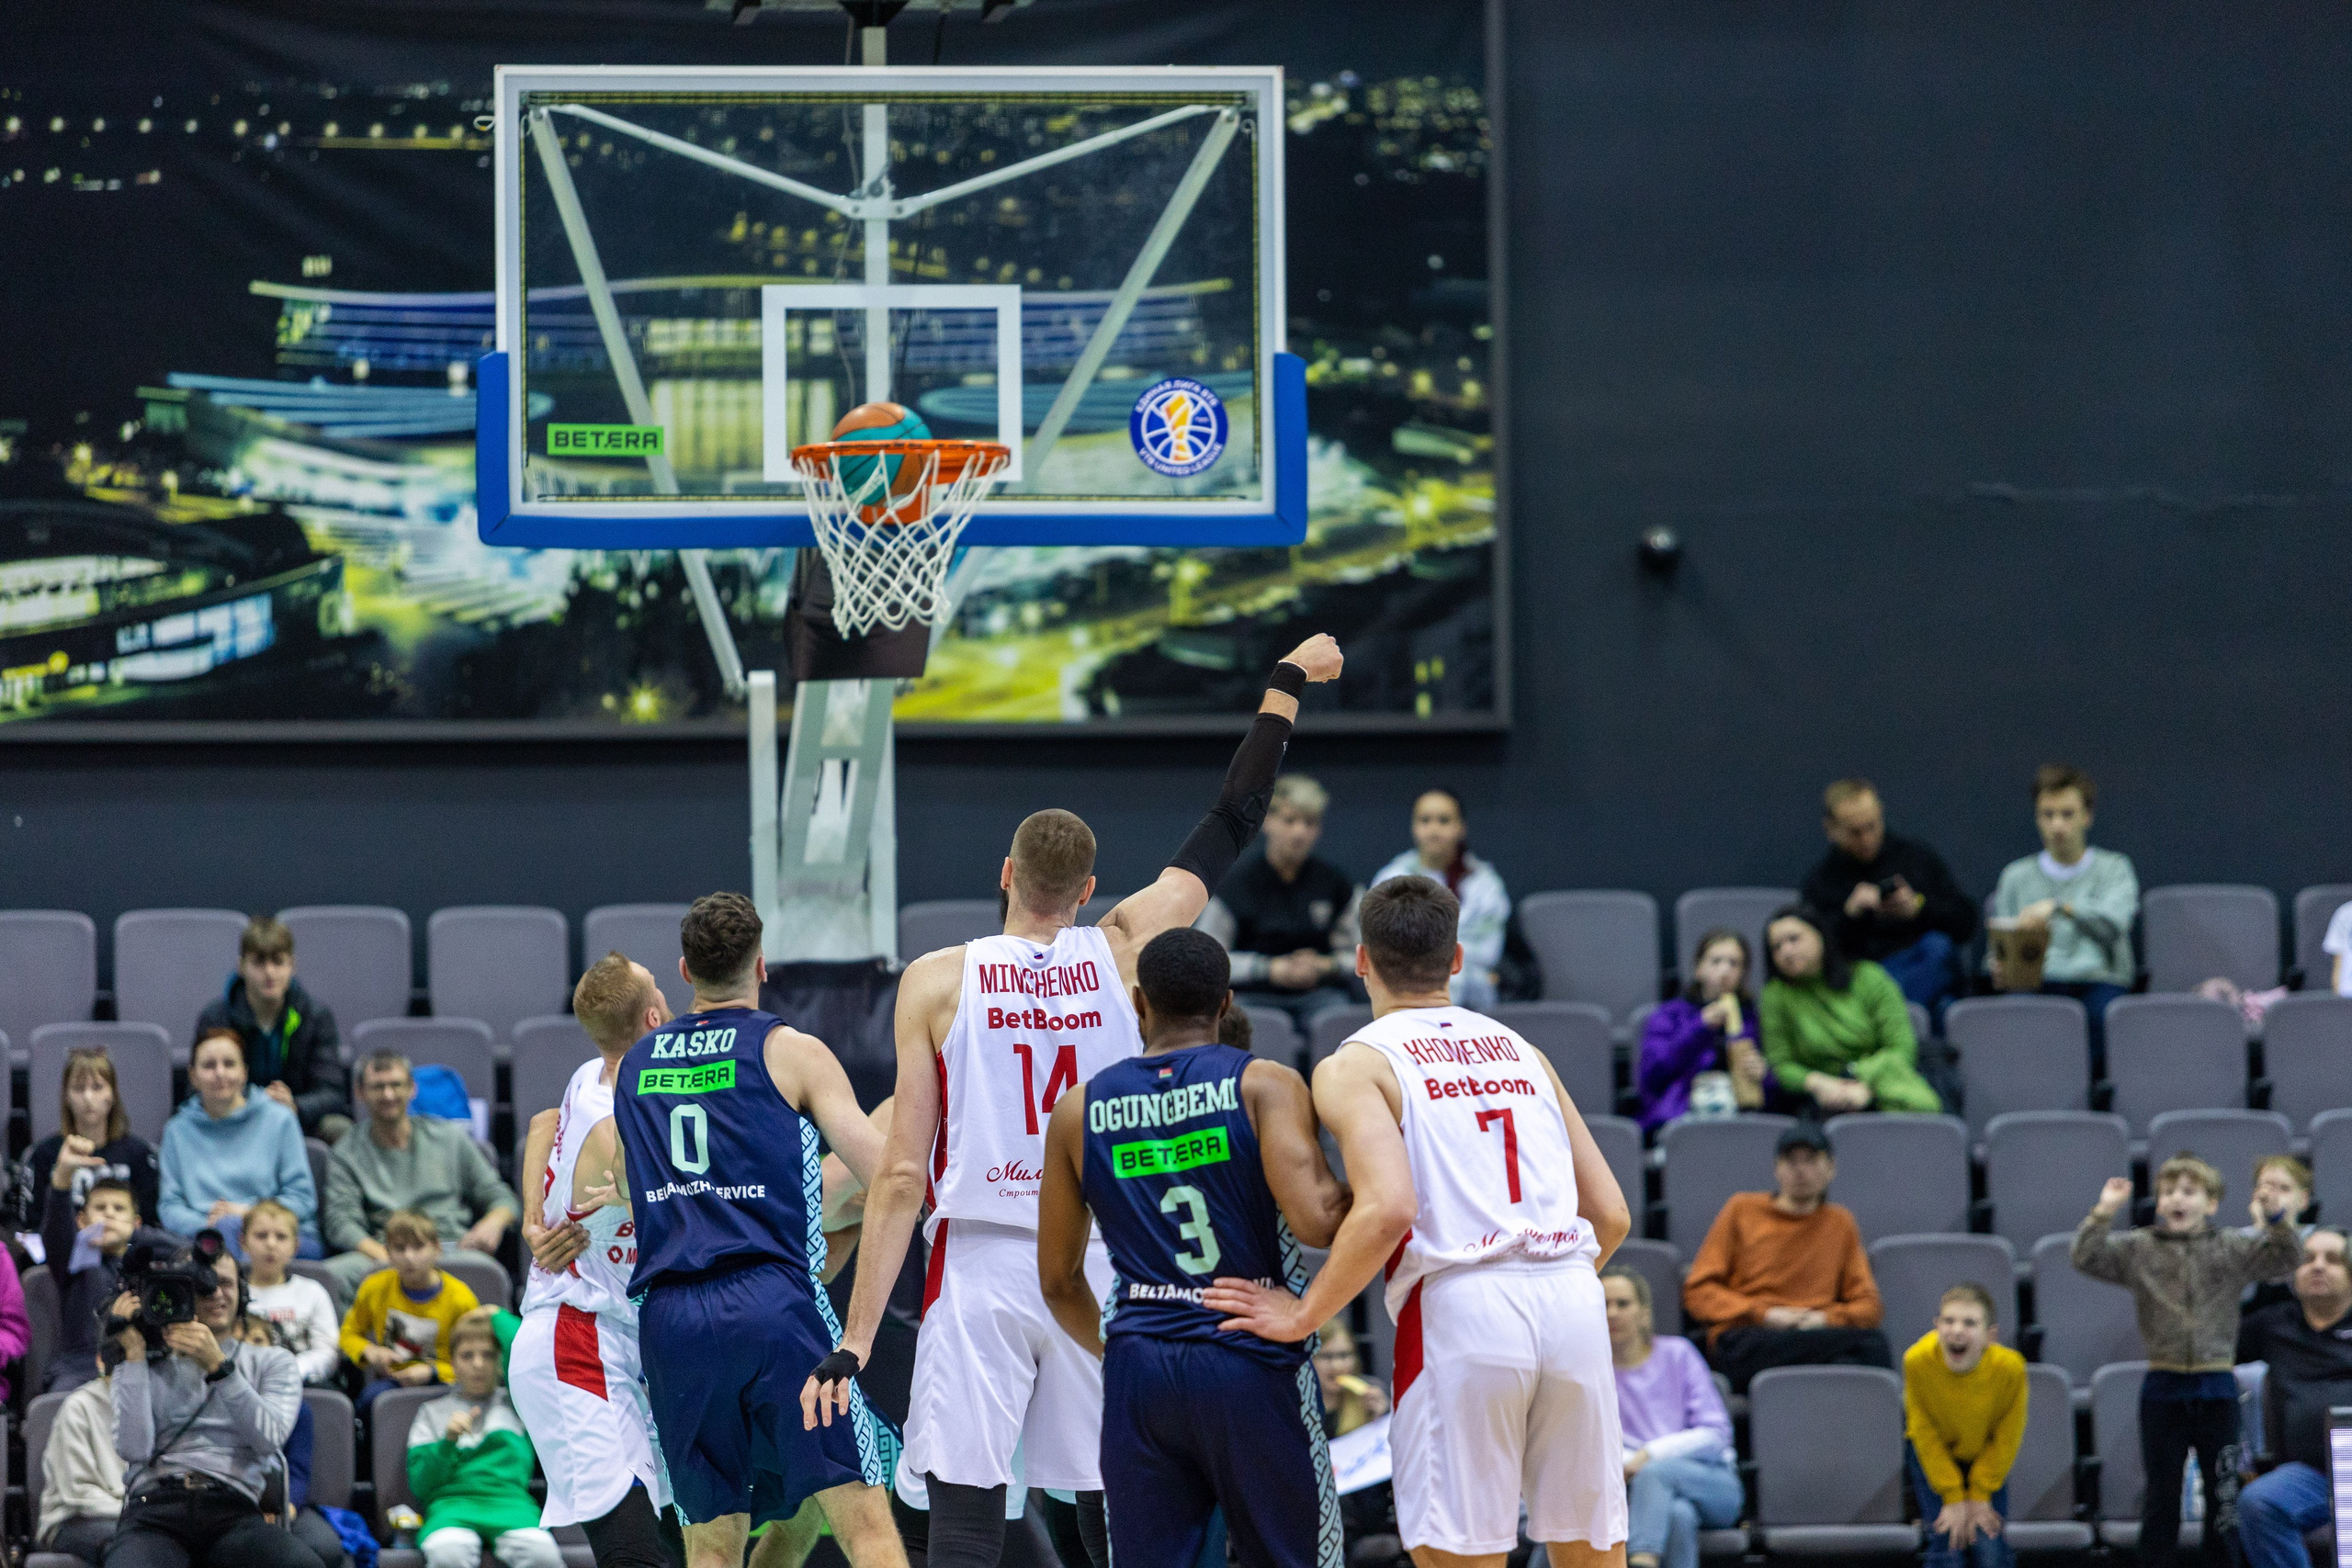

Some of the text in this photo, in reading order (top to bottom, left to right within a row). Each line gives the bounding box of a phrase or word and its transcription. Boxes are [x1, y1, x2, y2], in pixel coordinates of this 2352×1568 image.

[978, 960, 1100, 998] MINCHENKO
[650, 1027, 738, 1058] KASKO
[988, 1007, 1102, 1031] BetBoom
[1013, 1043, 1078, 1134] 14
[1090, 1077, 1238, 1134] OGUNGBEMI
[670, 1103, 710, 1175] 0
[1475, 1108, 1521, 1204] 7
[1159, 1184, 1221, 1275] 3
